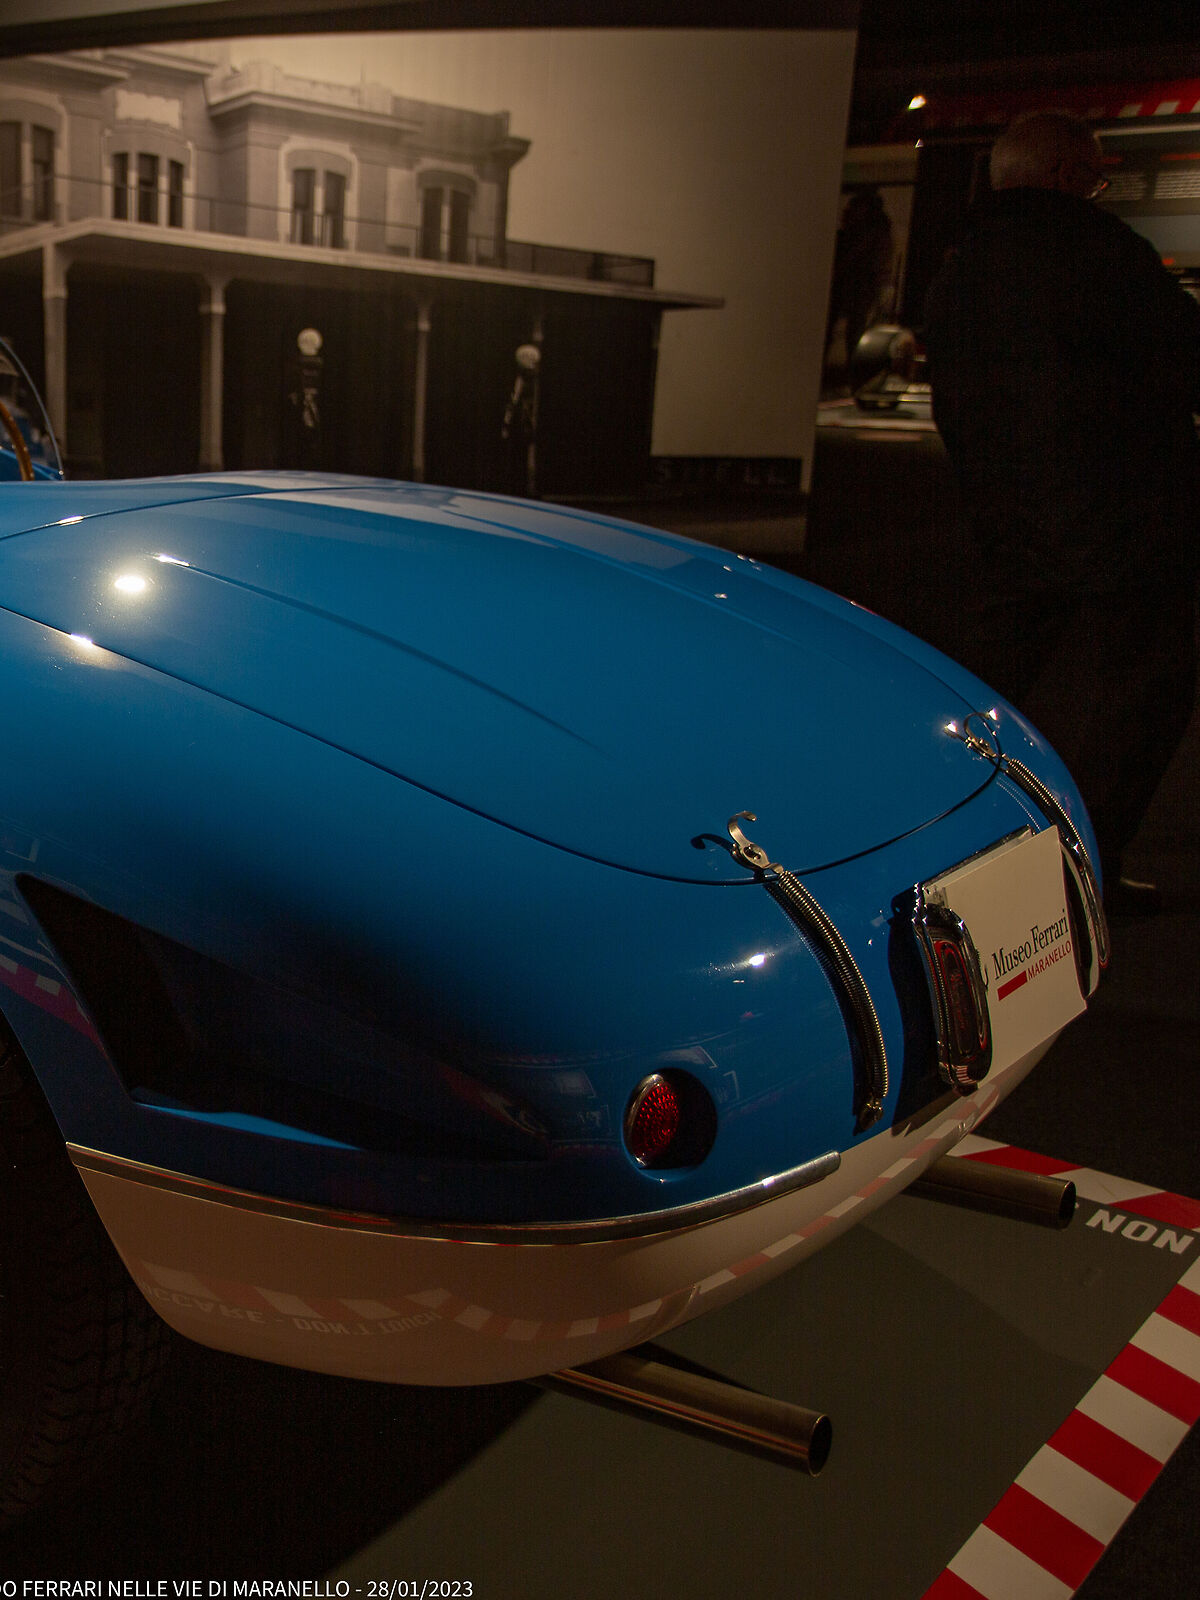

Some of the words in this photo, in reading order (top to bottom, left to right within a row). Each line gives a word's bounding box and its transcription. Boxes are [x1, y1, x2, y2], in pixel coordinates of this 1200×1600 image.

[991, 940, 1032, 981] Museo
[1030, 908, 1070, 955] Ferrari
[1027, 940, 1072, 981] MARANELLO
[1085, 1208, 1195, 1255] NON
